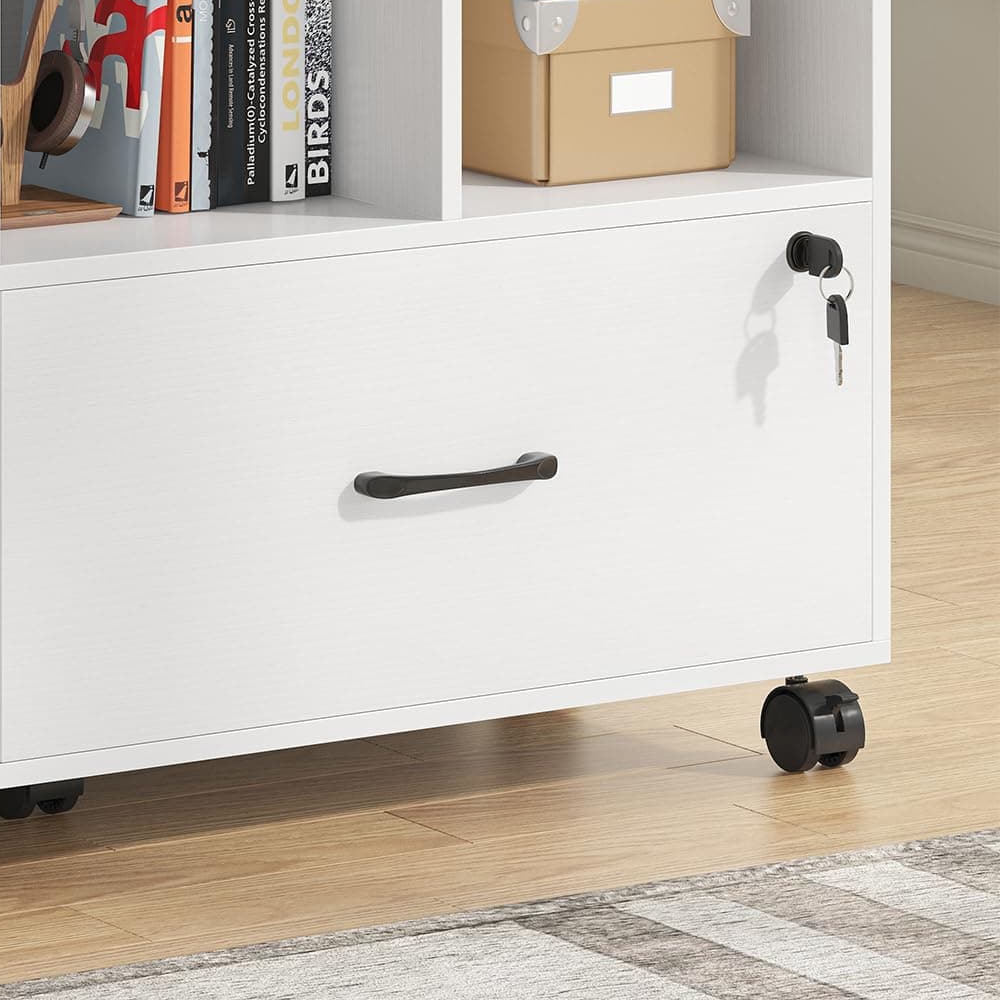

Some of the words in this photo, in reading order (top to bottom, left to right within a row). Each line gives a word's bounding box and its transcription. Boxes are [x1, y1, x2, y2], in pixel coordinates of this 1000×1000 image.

[247, 39, 257, 185] Palladium(0)-Catalyzed
[257, 17, 267, 144] Cyclocondensations
[307, 70, 330, 184] BIRDS
